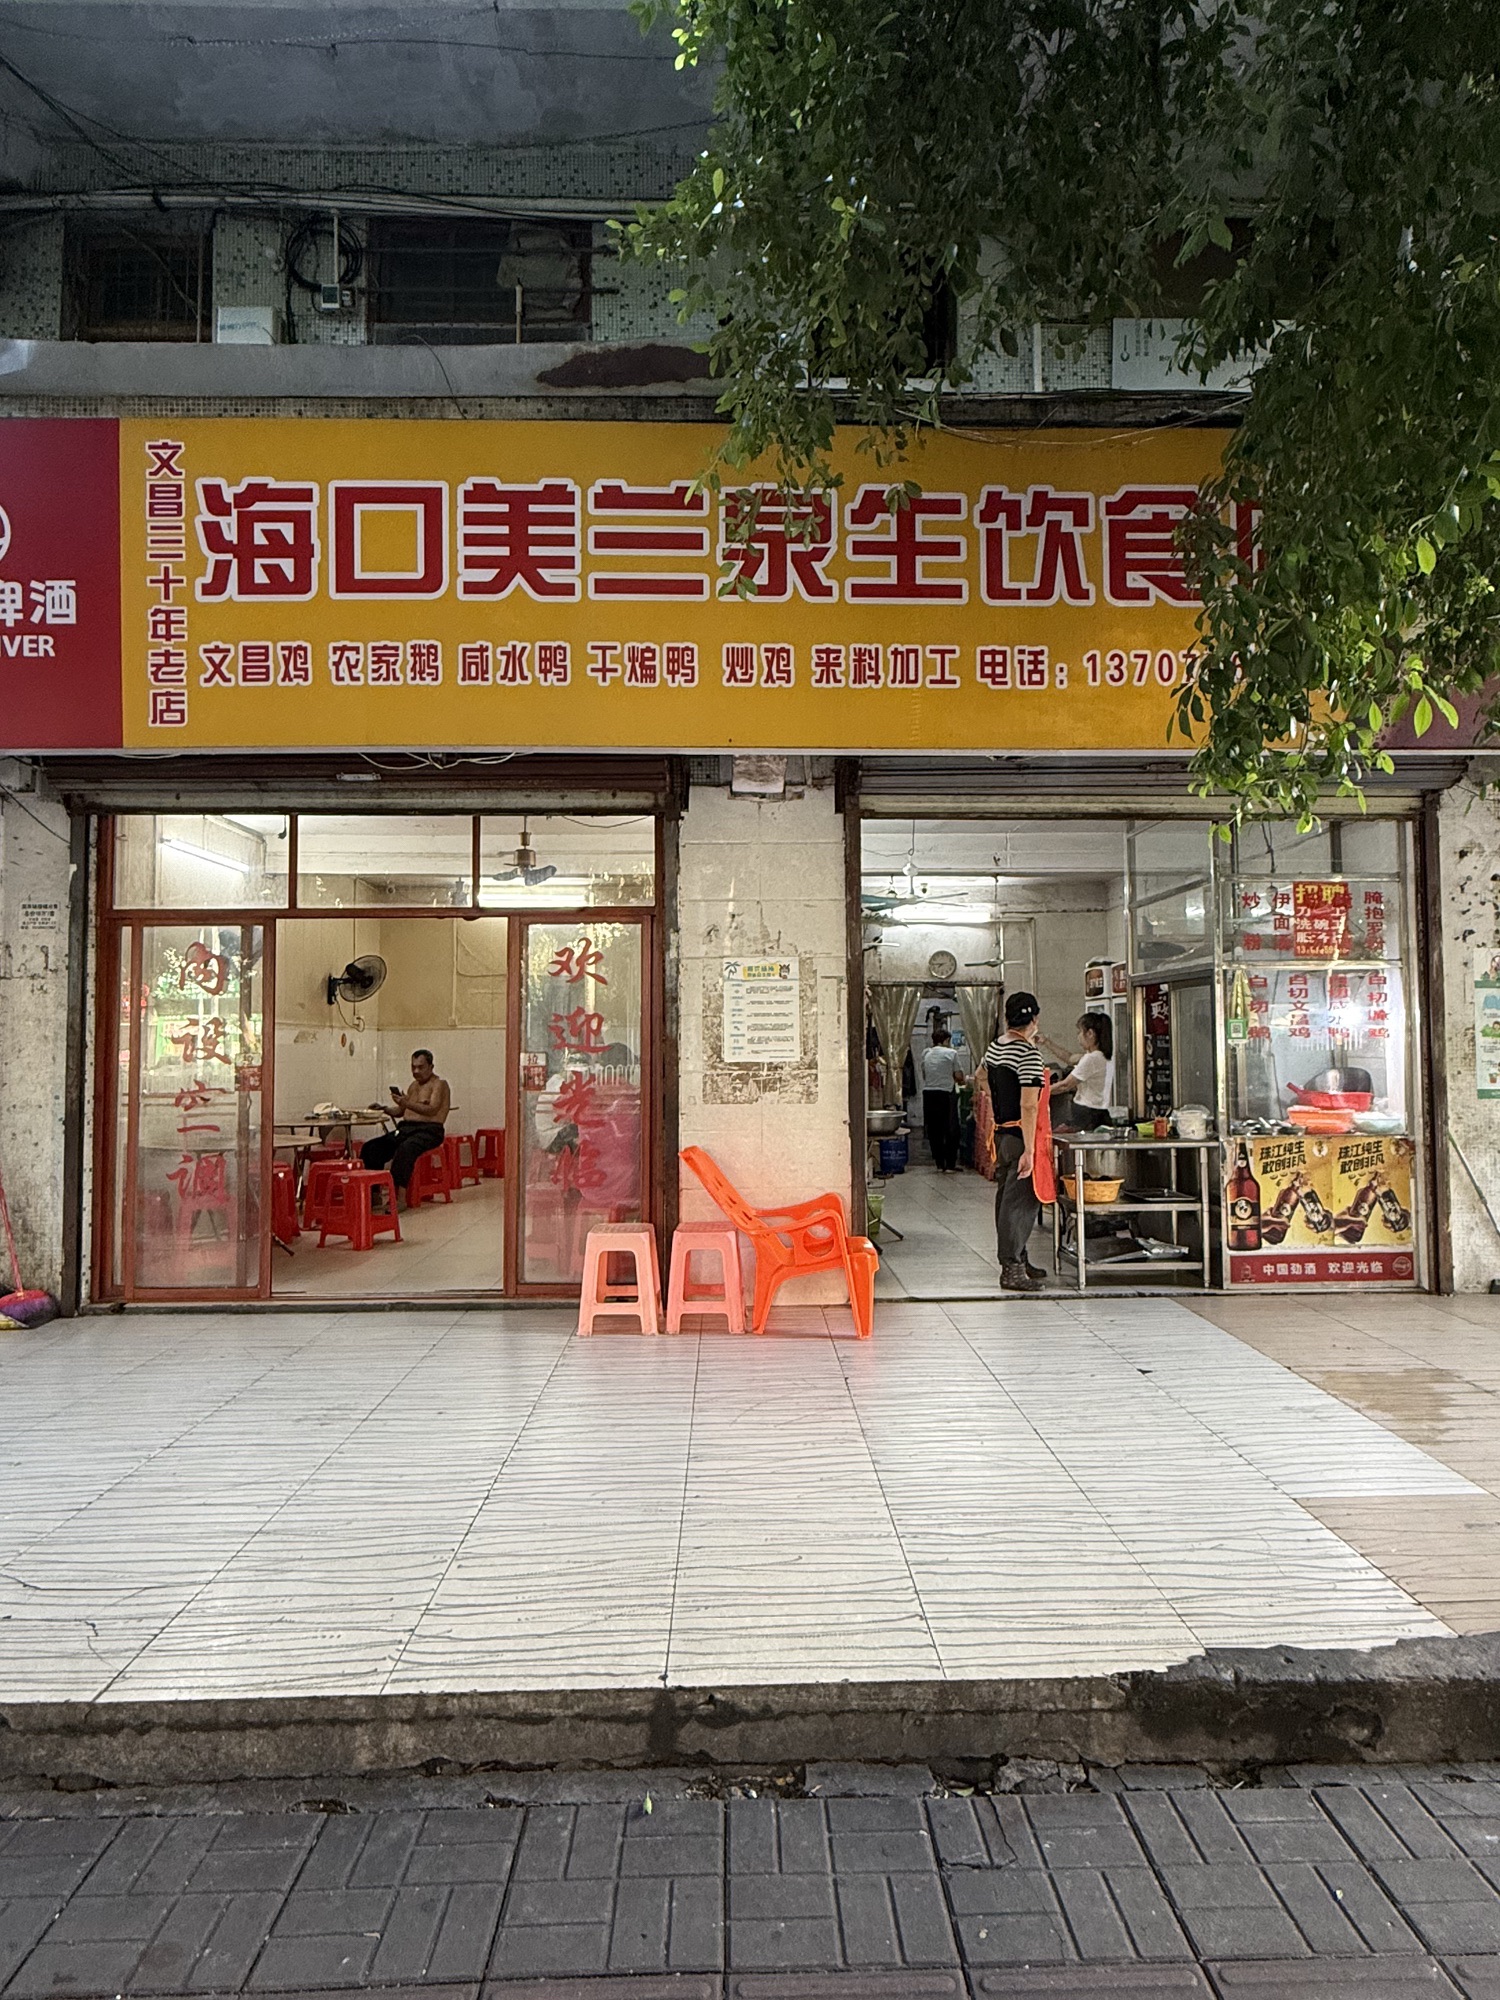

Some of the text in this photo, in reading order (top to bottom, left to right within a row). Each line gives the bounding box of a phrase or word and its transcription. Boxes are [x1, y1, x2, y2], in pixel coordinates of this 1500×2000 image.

[197, 476, 1268, 602] 海口美兰泉生饮食
[145, 439, 188, 728] 文昌三十年老店
[0, 634, 56, 658] VER
[200, 642, 312, 686] 文昌鸡
[328, 642, 442, 686] 农家鹅
[457, 642, 572, 686] 咸水鸭
[588, 643, 698, 686] 干煸鸭
[723, 644, 794, 687] 炒鸡
[812, 646, 960, 687] 来料加工
[548, 937, 613, 1192] 欢迎光临
[1262, 1261, 1384, 1276] 中国劲酒 欢迎光临
